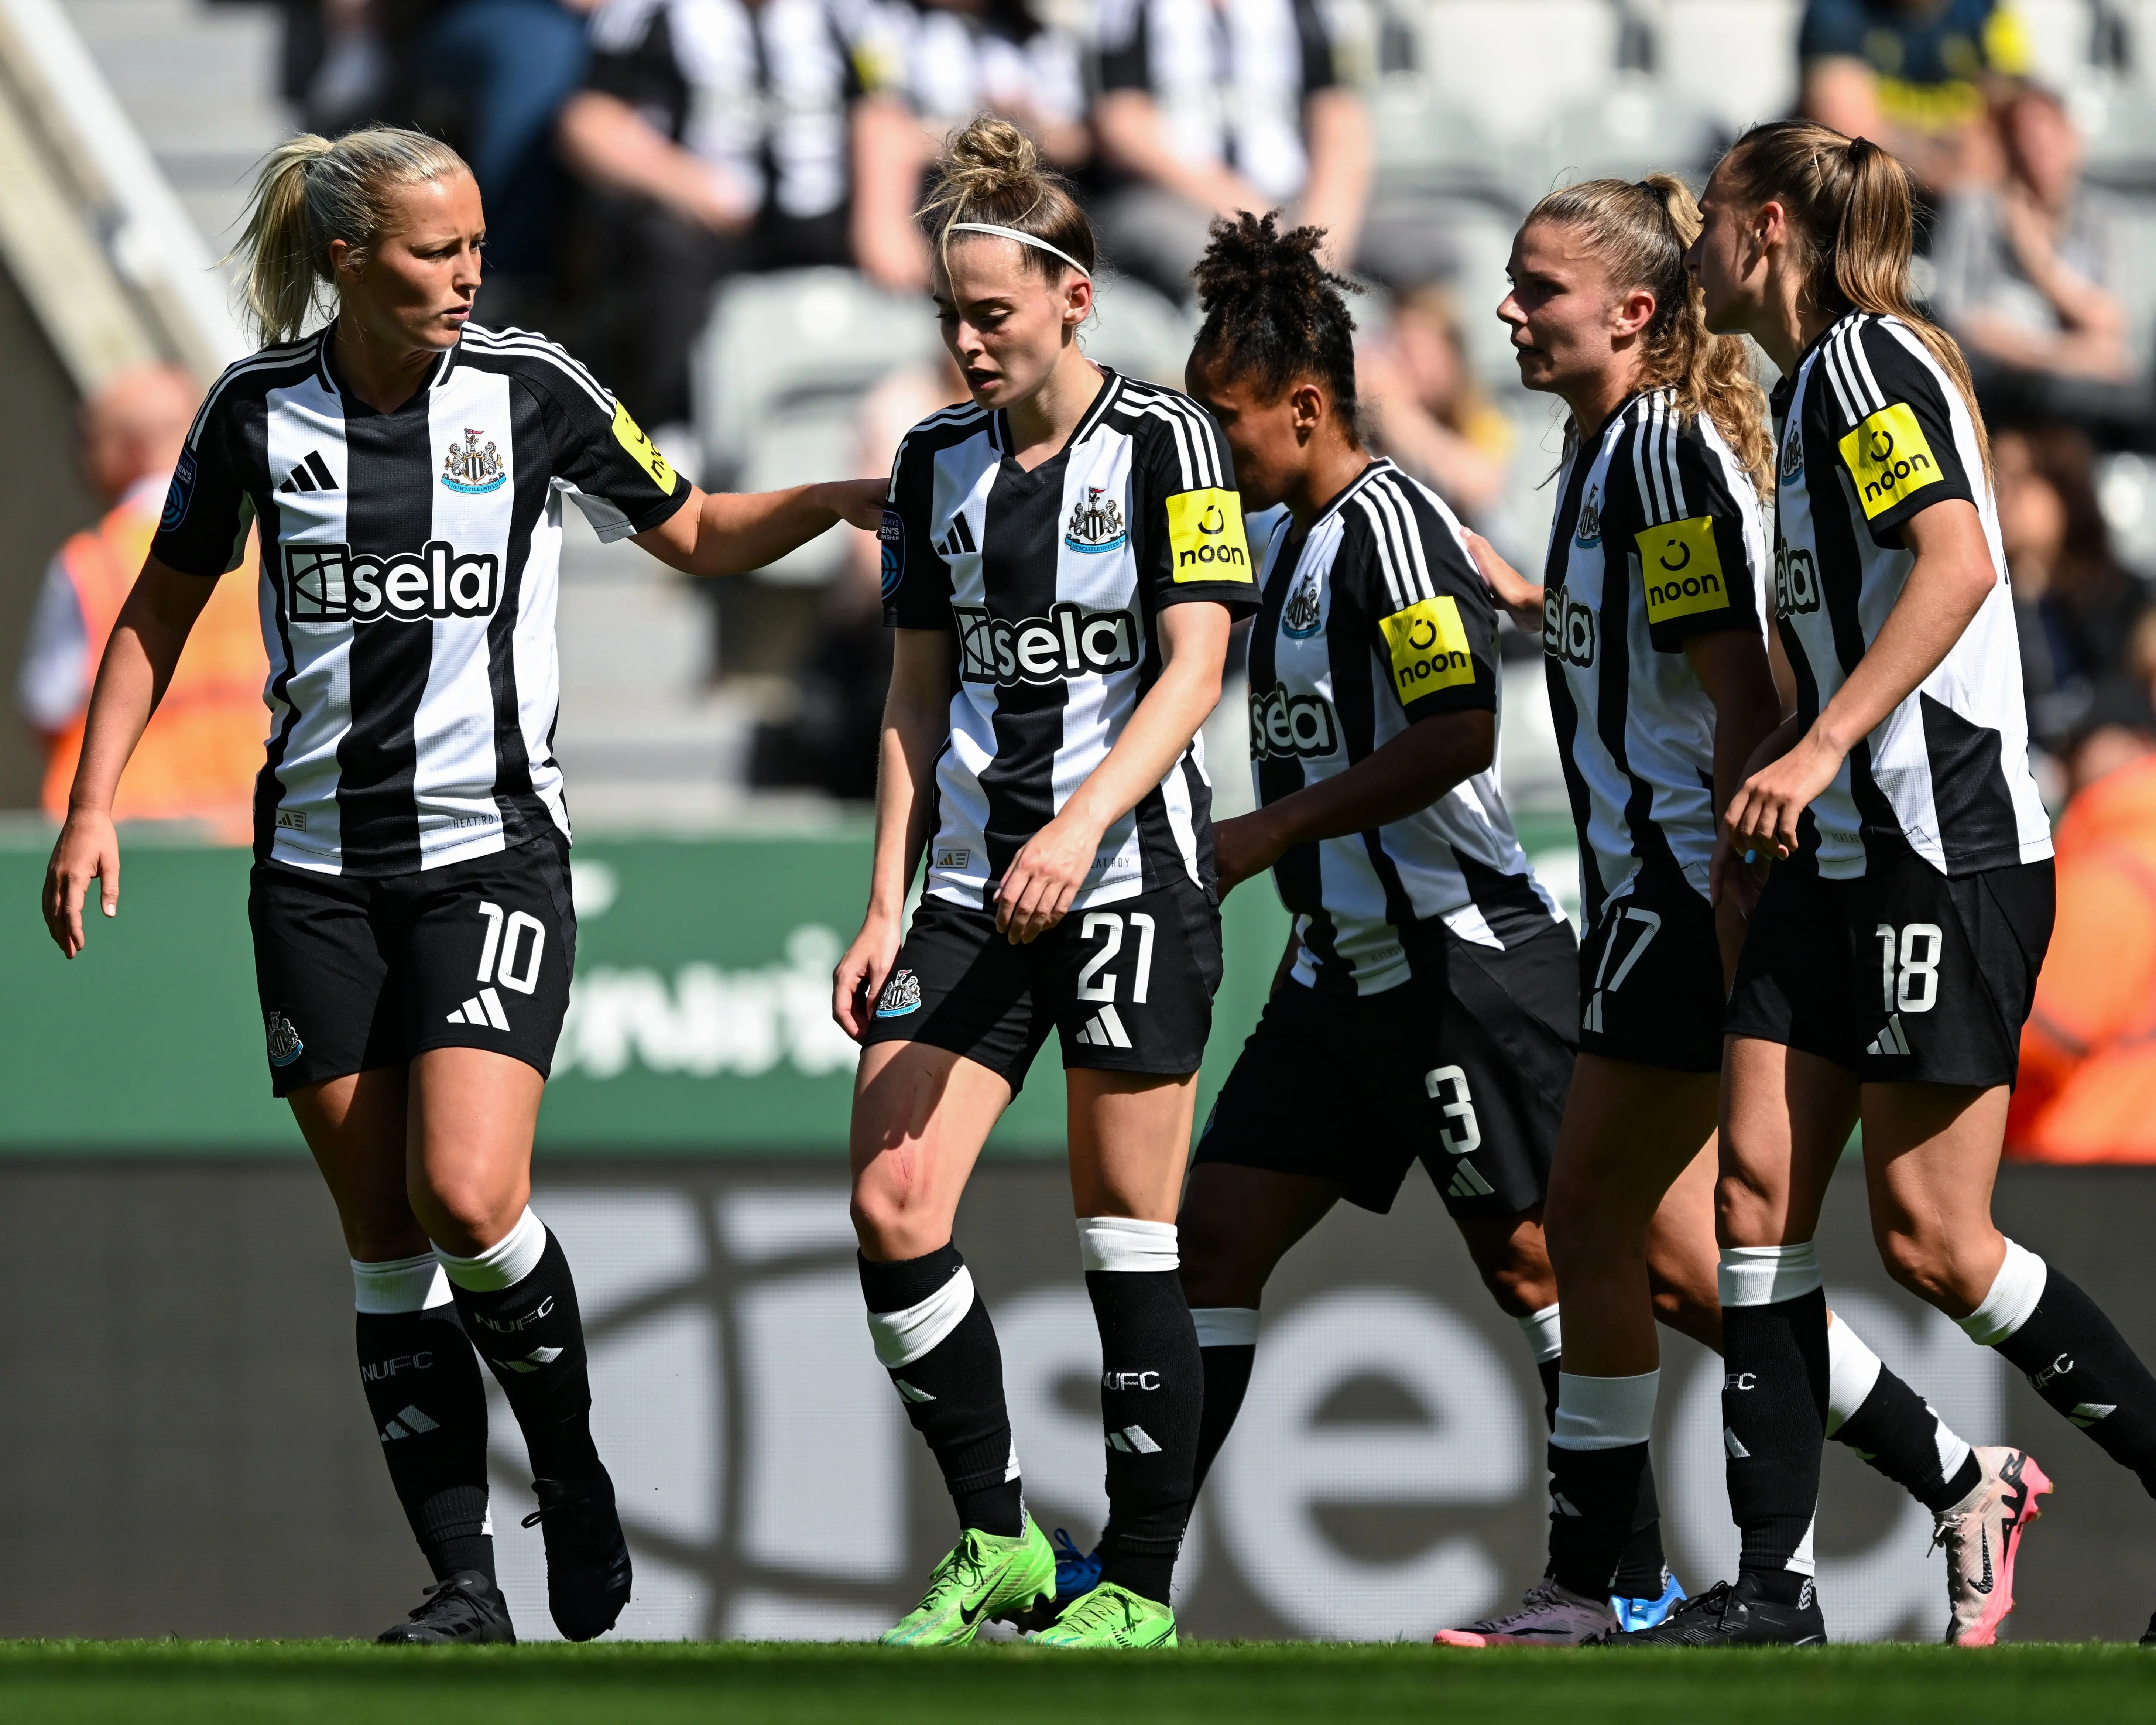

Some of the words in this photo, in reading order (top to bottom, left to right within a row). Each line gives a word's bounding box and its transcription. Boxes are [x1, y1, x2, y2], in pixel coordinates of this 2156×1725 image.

[650, 442, 665, 479] noo
[1864, 454, 1930, 503] noon
[480, 483, 498, 492] UNITED
[881, 526, 899, 535] EN'S
[882, 517, 899, 526] CLAYS
[1100, 541, 1120, 551] UNITED
[1180, 544, 1245, 567] noon
[352, 550, 491, 612] sela
[1649, 574, 1720, 606] noon
[1778, 547, 1816, 607] ela
[994, 611, 1131, 676] sela
[1399, 650, 1467, 688] noon
[453, 813, 499, 829] HEAT.RDY
[1831, 833, 1860, 843] HEAT.RD
[1091, 858, 1130, 869] AT.RDY
[476, 900, 546, 995] 10
[1076, 911, 1156, 1004] 21
[1594, 906, 1662, 992] 17
[1875, 923, 1943, 1013] 18
[1425, 1064, 1481, 1155] 3
[474, 1295, 554, 1333] NUFC
[362, 1351, 433, 1382] NUFC
[1724, 1372, 1756, 1390] FC
[2027, 1353, 2074, 1389] UFC
